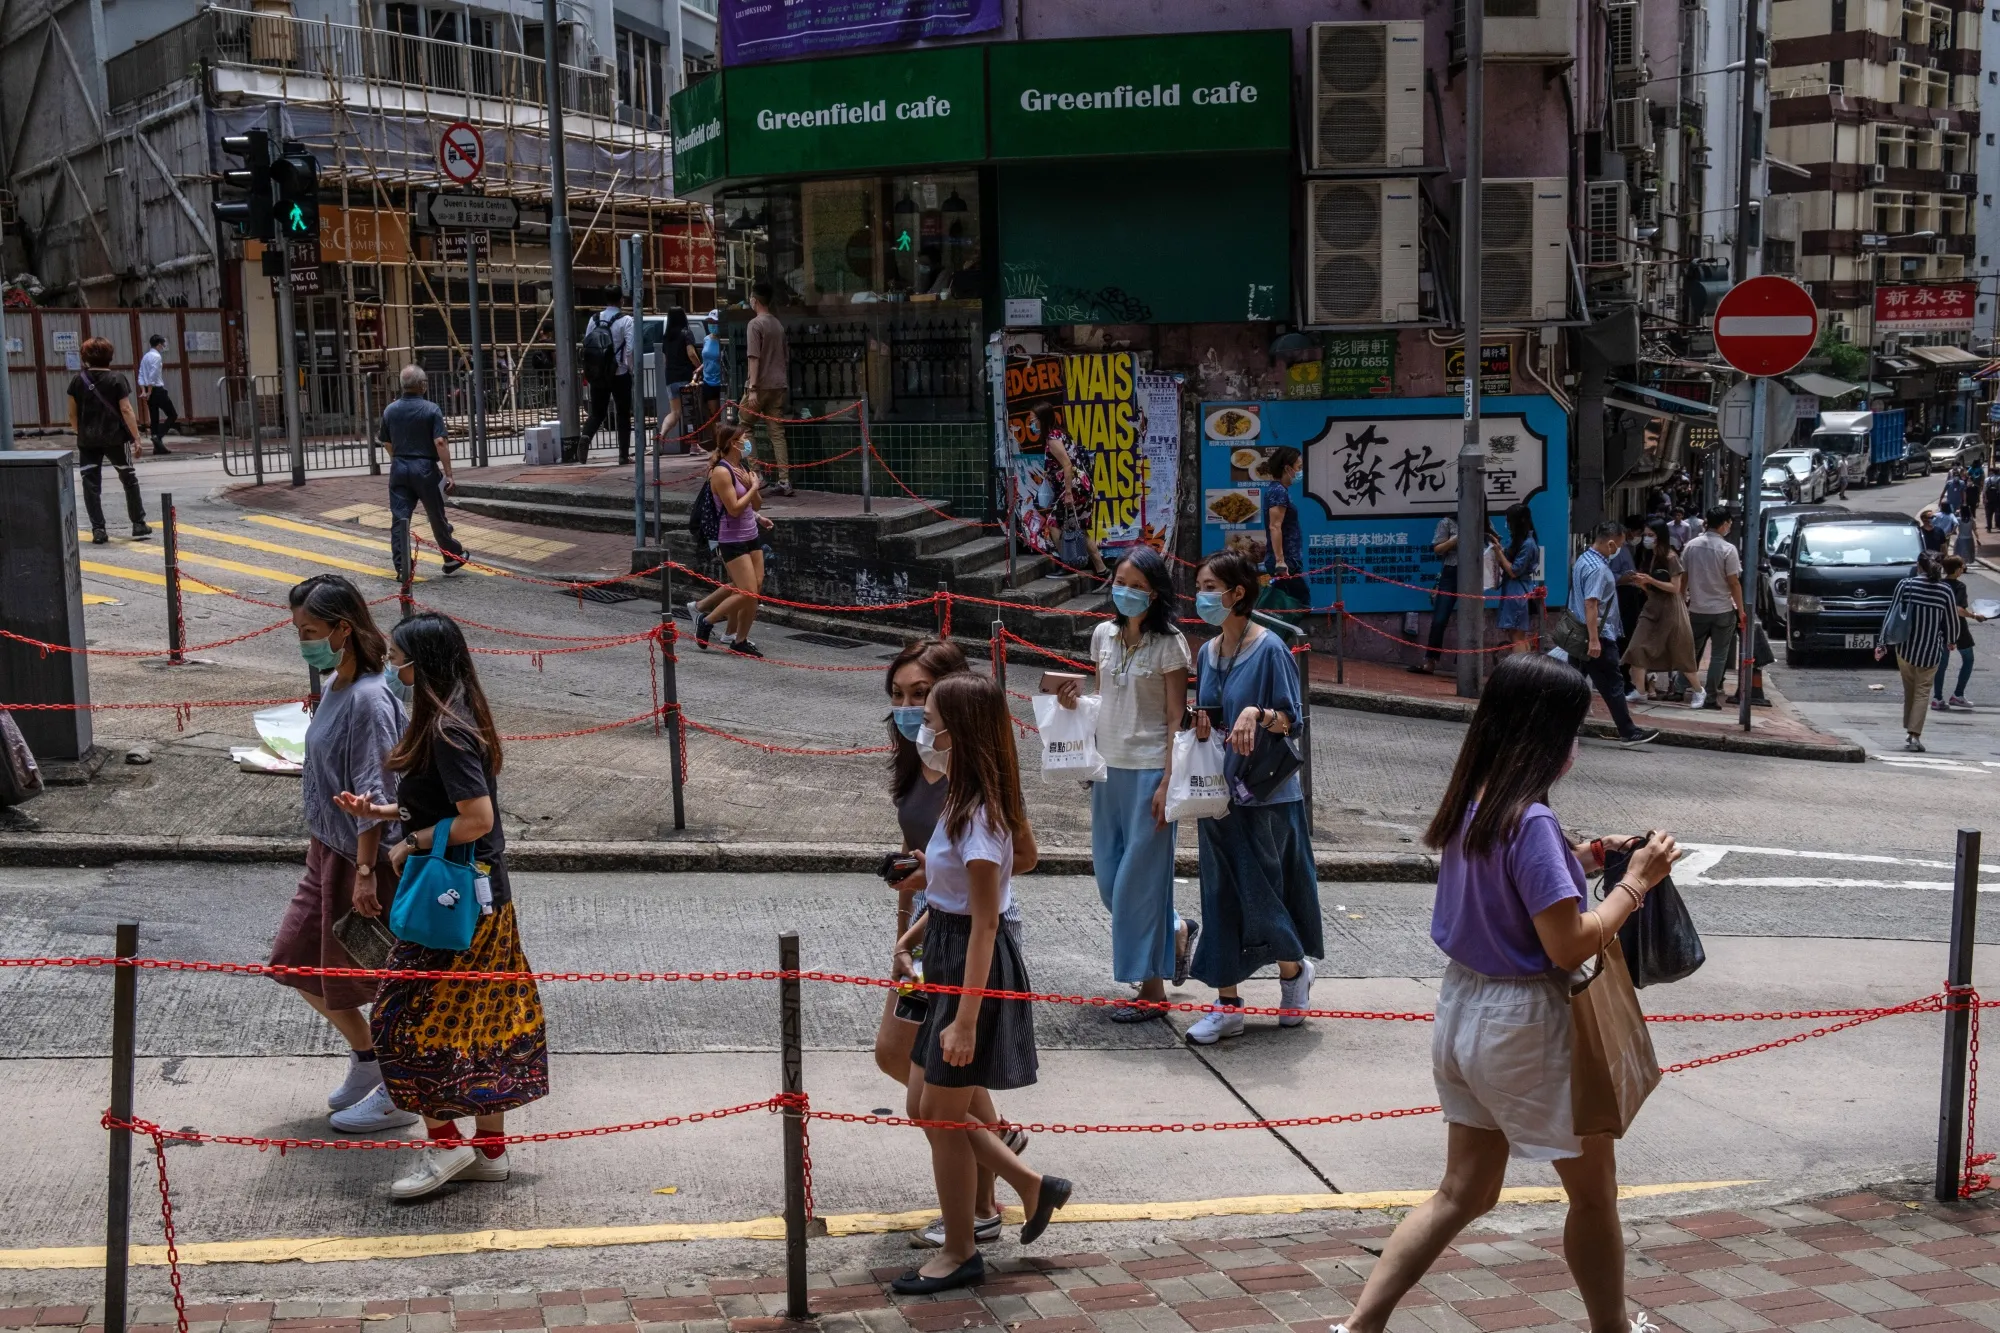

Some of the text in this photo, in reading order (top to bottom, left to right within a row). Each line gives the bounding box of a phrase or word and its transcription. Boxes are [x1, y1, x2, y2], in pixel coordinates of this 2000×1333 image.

[1020, 81, 1258, 111] Greenfield cafe
[757, 95, 950, 131] Greenfield cafe
[675, 117, 721, 155] Greenfield cafe
[443, 199, 508, 210] Queen's Road Central
[457, 211, 497, 223] 皇后大道中
[1885, 289, 1966, 306] 新永安
[1065, 354, 1132, 401] WAIS
[1330, 356, 1389, 368] 3707 6655
[1065, 402, 1135, 451] WAIS
[1093, 450, 1135, 499] AIS
[1332, 424, 1447, 508] 蘇杭
[1308, 532, 1409, 547] 正宗香港本地冰室
